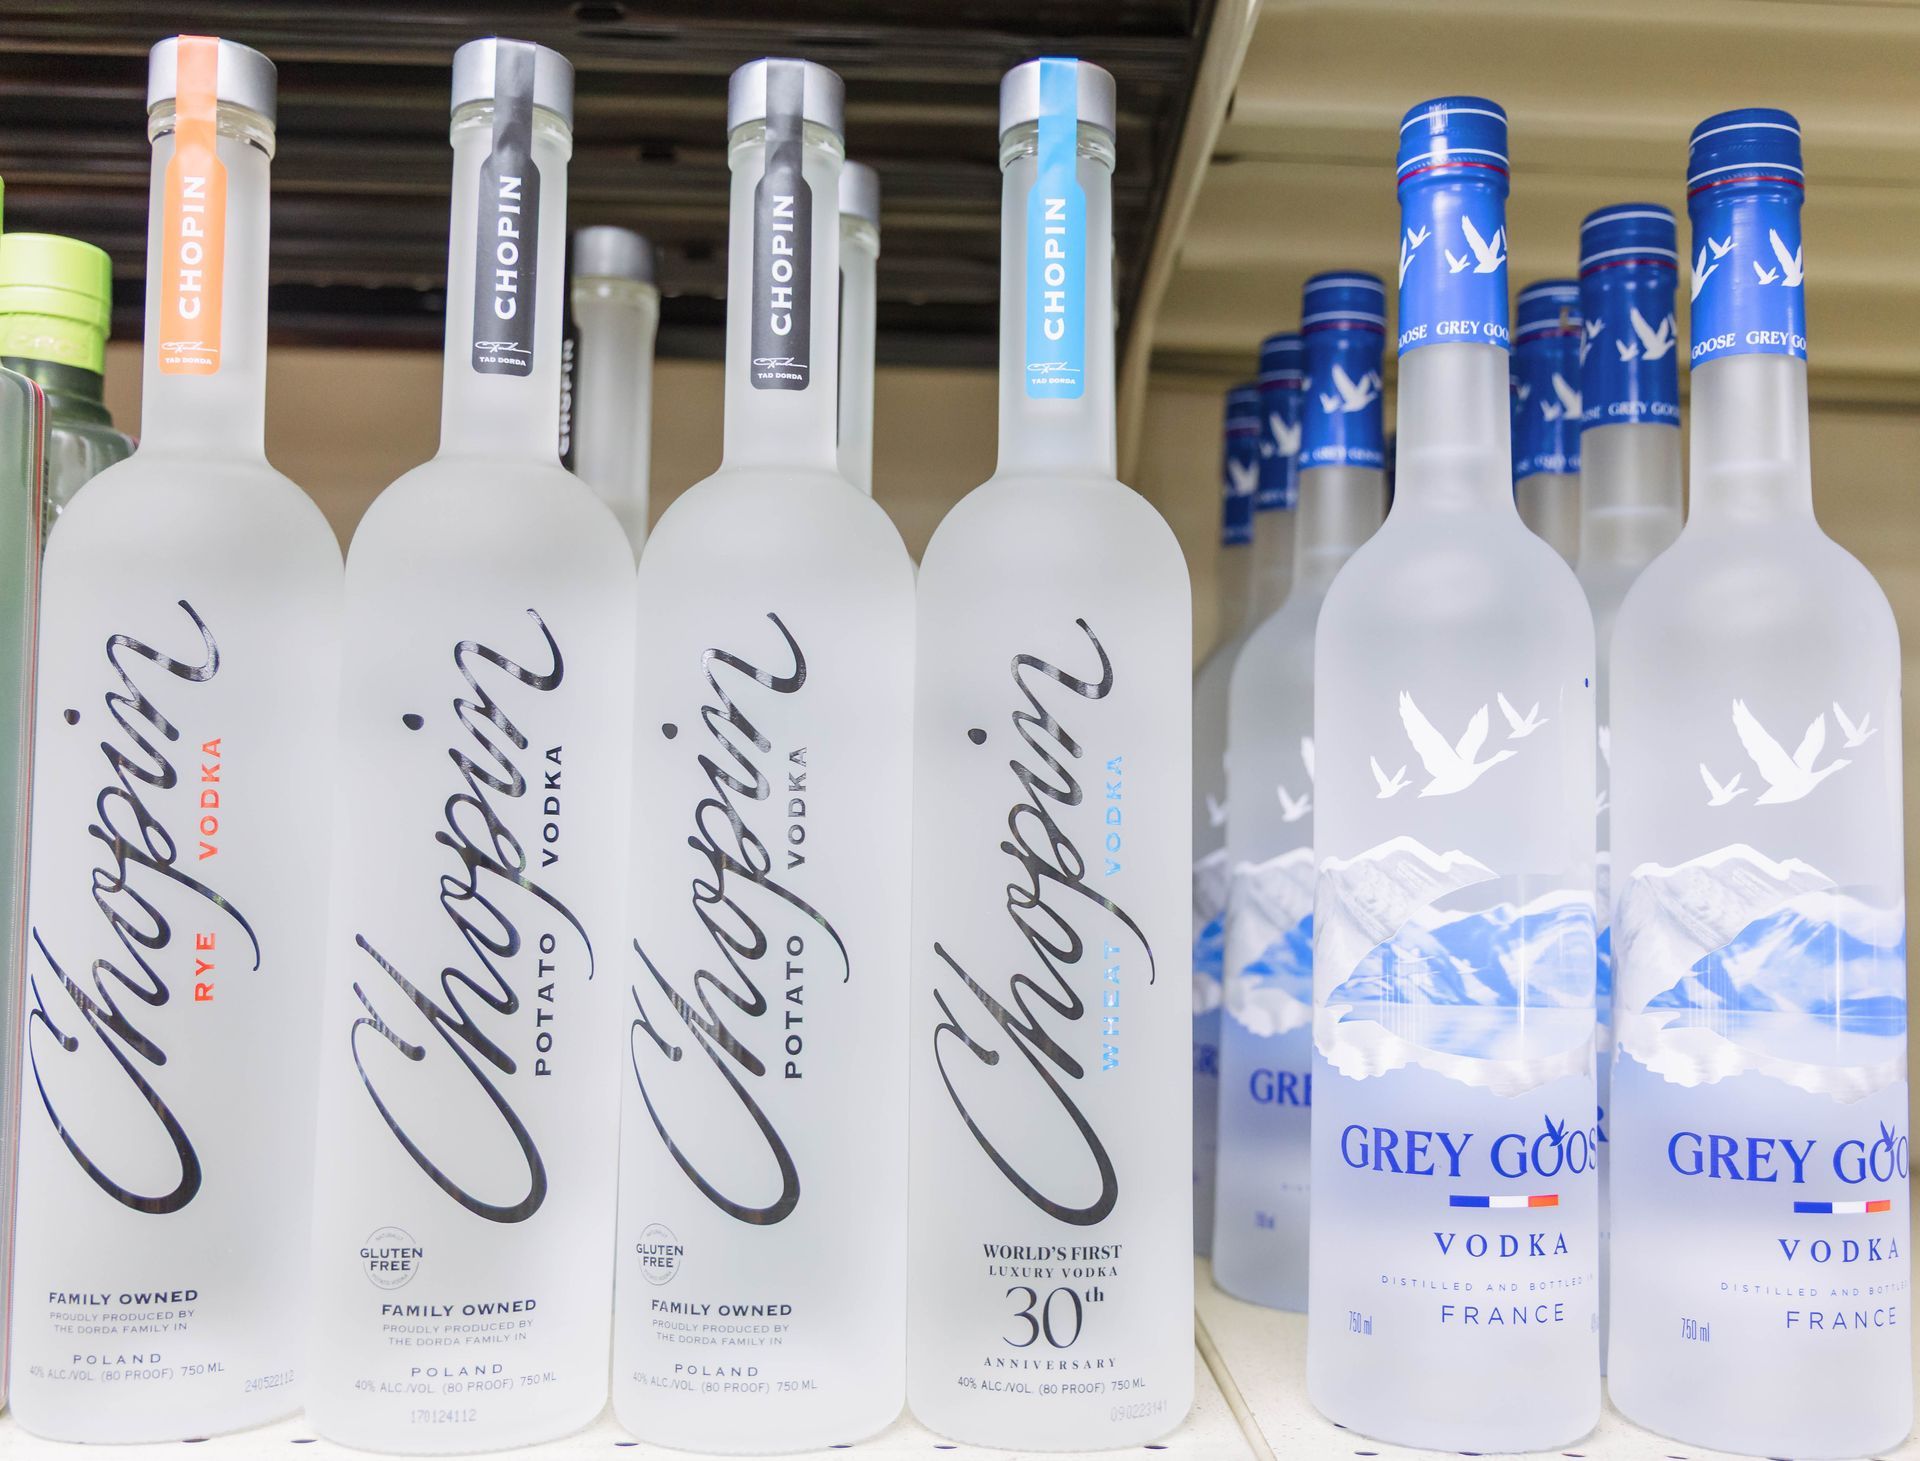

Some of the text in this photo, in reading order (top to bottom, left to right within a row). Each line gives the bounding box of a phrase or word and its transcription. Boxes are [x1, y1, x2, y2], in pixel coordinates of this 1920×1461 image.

[179, 175, 206, 320] CHOPIN
[494, 175, 522, 320] CHOPIN
[770, 194, 794, 336] CHOPIN
[1044, 198, 1066, 341] CHOPIN
[1398, 320, 1509, 348] OOSE GREY GOO
[1691, 333, 1736, 359] GOOSE
[1746, 331, 1788, 345] GREY
[498, 357, 526, 366] DORDA
[195, 738, 222, 1002] RYE VODKA
[28, 600, 259, 1214] Chopin
[351, 608, 594, 1224] Chopin
[535, 745, 562, 1077] POTATO VODKA
[785, 746, 807, 1079] POTATO VODKA
[1103, 756, 1124, 1071] WHEAT VODKA
[631, 612, 849, 1226] Chopin
[934, 618, 1155, 1226] Chopin
[1341, 1124, 1474, 1177] GREY
[1668, 1131, 1908, 1184] GREY GOO
[360, 1247, 423, 1259] GLUTEN
[636, 1243, 683, 1256] GLUTEN
[983, 1244, 1122, 1261] WORLD'S FIRST
[1434, 1232, 1568, 1257] VODKA
[1777, 1237, 1899, 1263] VODKA
[370, 1260, 411, 1271] FREE
[643, 1256, 674, 1268] FREE
[989, 1265, 1118, 1278] LUXURY VODKA
[1381, 1275, 1473, 1291] DISTILLED
[1486, 1283, 1518, 1292] AND
[1721, 1282, 1818, 1297] DISTILLED
[1830, 1288, 1859, 1297] AND
[49, 1290, 198, 1305] FAMILY OWNED
[50, 1310, 195, 1322] PROUDLY PRODUCED BY
[382, 1299, 536, 1316] FAMILY OWNED
[651, 1300, 792, 1316] FAMILY OWNED
[1441, 1303, 1564, 1325] FRANCE
[1002, 1286, 1104, 1348] 30th
[1349, 1311, 1372, 1335] 750 ml
[1787, 1307, 1896, 1330] FRANCE
[54, 1323, 187, 1334] THE DORDA FAMILY IN
[383, 1319, 534, 1334] PROUDLY PRODUCED BY
[652, 1320, 789, 1334] PROUDLY PRODUCED BY
[1681, 1317, 1710, 1342] 750 ml
[389, 1332, 526, 1346] THE DORDA FAMILY IN
[656, 1332, 782, 1346] THE DORDA FAMILY IN
[73, 1354, 161, 1365] POLAND
[984, 1357, 1117, 1370] ANNIVERSARY
[101, 1370, 120, 1382] (80
[125, 1368, 174, 1381] PROOF)
[181, 1365, 204, 1377] 750
[208, 1363, 224, 1373] ML
[411, 1364, 503, 1377] POLAND
[675, 1363, 758, 1377] POLAND
[355, 1380, 376, 1393] 40%
[442, 1382, 463, 1395] (80
[467, 1379, 513, 1392] PROOF)
[520, 1375, 540, 1386] 750
[543, 1372, 556, 1382] ML
[701, 1382, 720, 1394] (80
[724, 1382, 770, 1394] PROOF)
[776, 1381, 799, 1392] 750
[802, 1380, 817, 1390] ML
[958, 1377, 977, 1389] 40%
[1039, 1383, 1057, 1395] (80
[1062, 1382, 1105, 1395] PROOF)
[1111, 1380, 1130, 1391] 750
[1132, 1377, 1146, 1388] ML
[411, 1409, 477, 1424] 170124112
